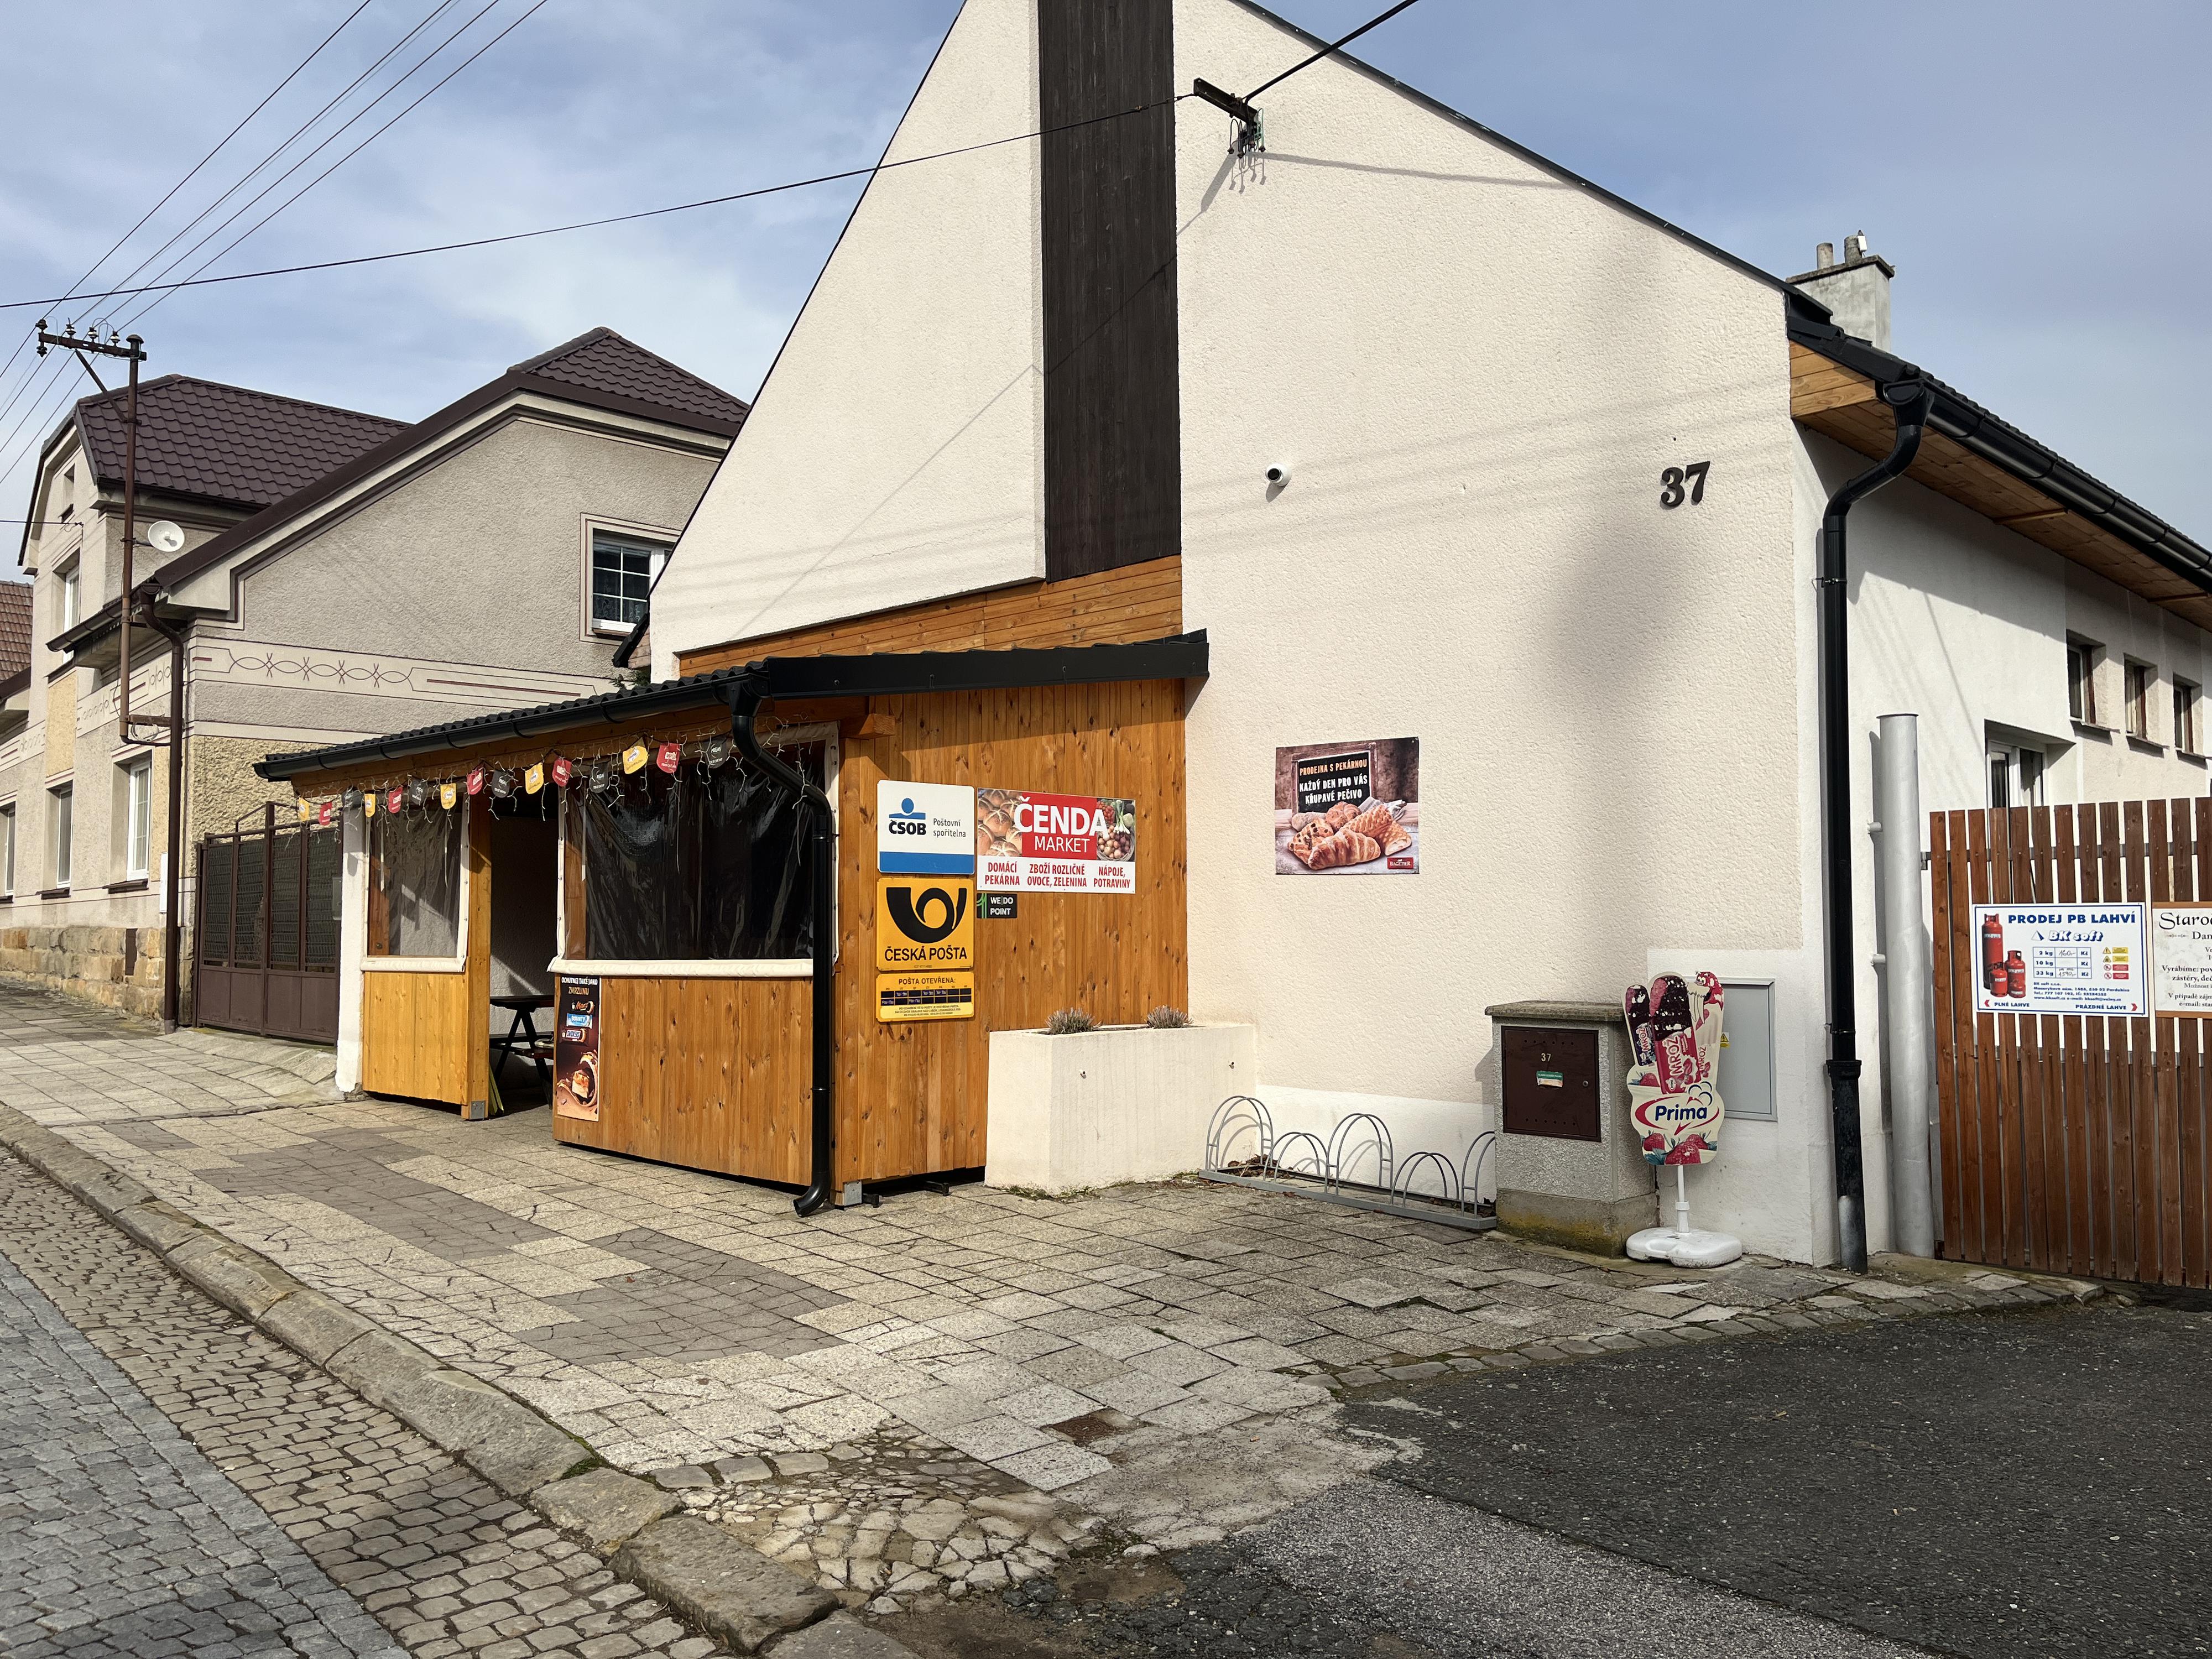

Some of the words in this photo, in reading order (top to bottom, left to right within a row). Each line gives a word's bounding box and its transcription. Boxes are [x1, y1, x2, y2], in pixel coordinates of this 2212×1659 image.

[1661, 461, 1710, 507] 37
[1300, 763, 1328, 776] PRODEJNA
[1335, 759, 1368, 771] PEKÁRNOU
[1300, 778, 1321, 792] KAŽDÝ
[1323, 780, 1335, 790] DEN
[1338, 778, 1352, 787] PRO
[1354, 773, 1368, 785] VÁS
[1305, 790, 1335, 804] KŘUPAVÉ
[1337, 789, 1362, 802] PEČIVO
[933, 818, 961, 827] Poštovní
[1014, 796, 1109, 838] ČENDA
[889, 820, 926, 835] ČSOB
[933, 829, 966, 838] spořitelna
[1034, 836, 1091, 853] MARKET
[988, 861, 1017, 873] DOMÁCÍ
[1029, 863, 1050, 874] ZBOŽÍ
[1052, 864, 1085, 875] ROZLIČNÉ
[1098, 864, 1125, 878] NÁPOJE,
[985, 874, 1020, 885] PEKÁRNA
[1027, 876, 1052, 888] OVOCE,
[1053, 877, 1087, 887] ZELENINA
[1093, 878, 1131, 888] POTRAVINY
[2008, 914, 2062, 924] PRODEJ
[2068, 914, 2086, 924] PB
[2091, 911, 2136, 924] LAHVÍ
[2159, 912, 2212, 930] Staro
[2048, 930, 2072, 941] BK
[2073, 930, 2104, 942] soft
[885, 946, 927, 961] ČESKÁ
[929, 945, 968, 960] POŠTA
[579, 976, 588, 984] TAKÉ
[921, 976, 955, 984] OTEVŘENA:
[1541, 1053, 1551, 1062] 37
[1655, 1103, 1708, 1122] Prima
